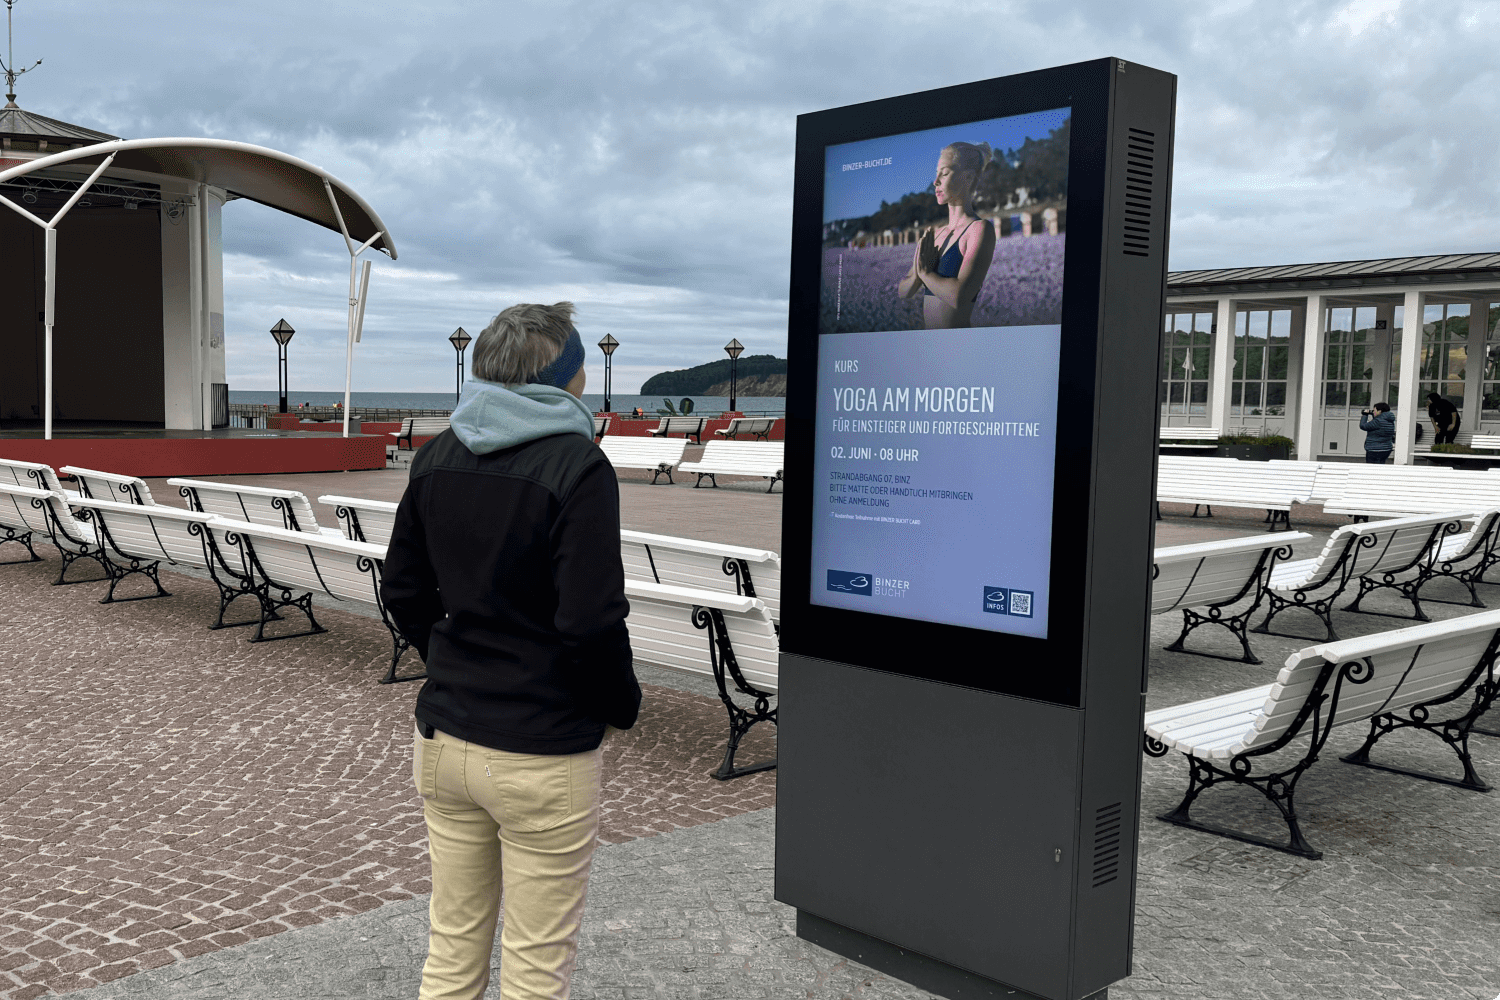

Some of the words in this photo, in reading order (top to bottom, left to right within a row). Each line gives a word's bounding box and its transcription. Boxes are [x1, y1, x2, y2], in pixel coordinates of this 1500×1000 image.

[842, 157, 892, 171] BINZER-BUCHT.DE
[835, 360, 858, 372] KURS
[834, 388, 877, 411] YOGA
[882, 388, 909, 412] AM
[915, 387, 994, 413] MORGEN
[833, 417, 849, 432] FÜR
[852, 420, 906, 433] EINSTEIGER
[909, 421, 930, 434] UND
[932, 421, 1040, 437] FORTGESCHRITTENE
[831, 447, 846, 458] 02.
[849, 447, 871, 460] JUNI
[880, 449, 893, 460] 08
[896, 449, 918, 461] UHR
[830, 472, 882, 482] STRANDABGANG
[884, 475, 893, 483] 07,
[895, 475, 910, 484] BINZ
[830, 484, 846, 492] BITTE
[848, 485, 868, 493] MATTE
[870, 486, 888, 495] ODER
[890, 488, 927, 497] HANDTUCH
[929, 490, 973, 500] MITBRINGEN
[830, 496, 847, 504] OHNE
[848, 497, 889, 507] ANMELDUNG
[875, 577, 910, 590] BINZER
[875, 587, 906, 598] BUCHT
